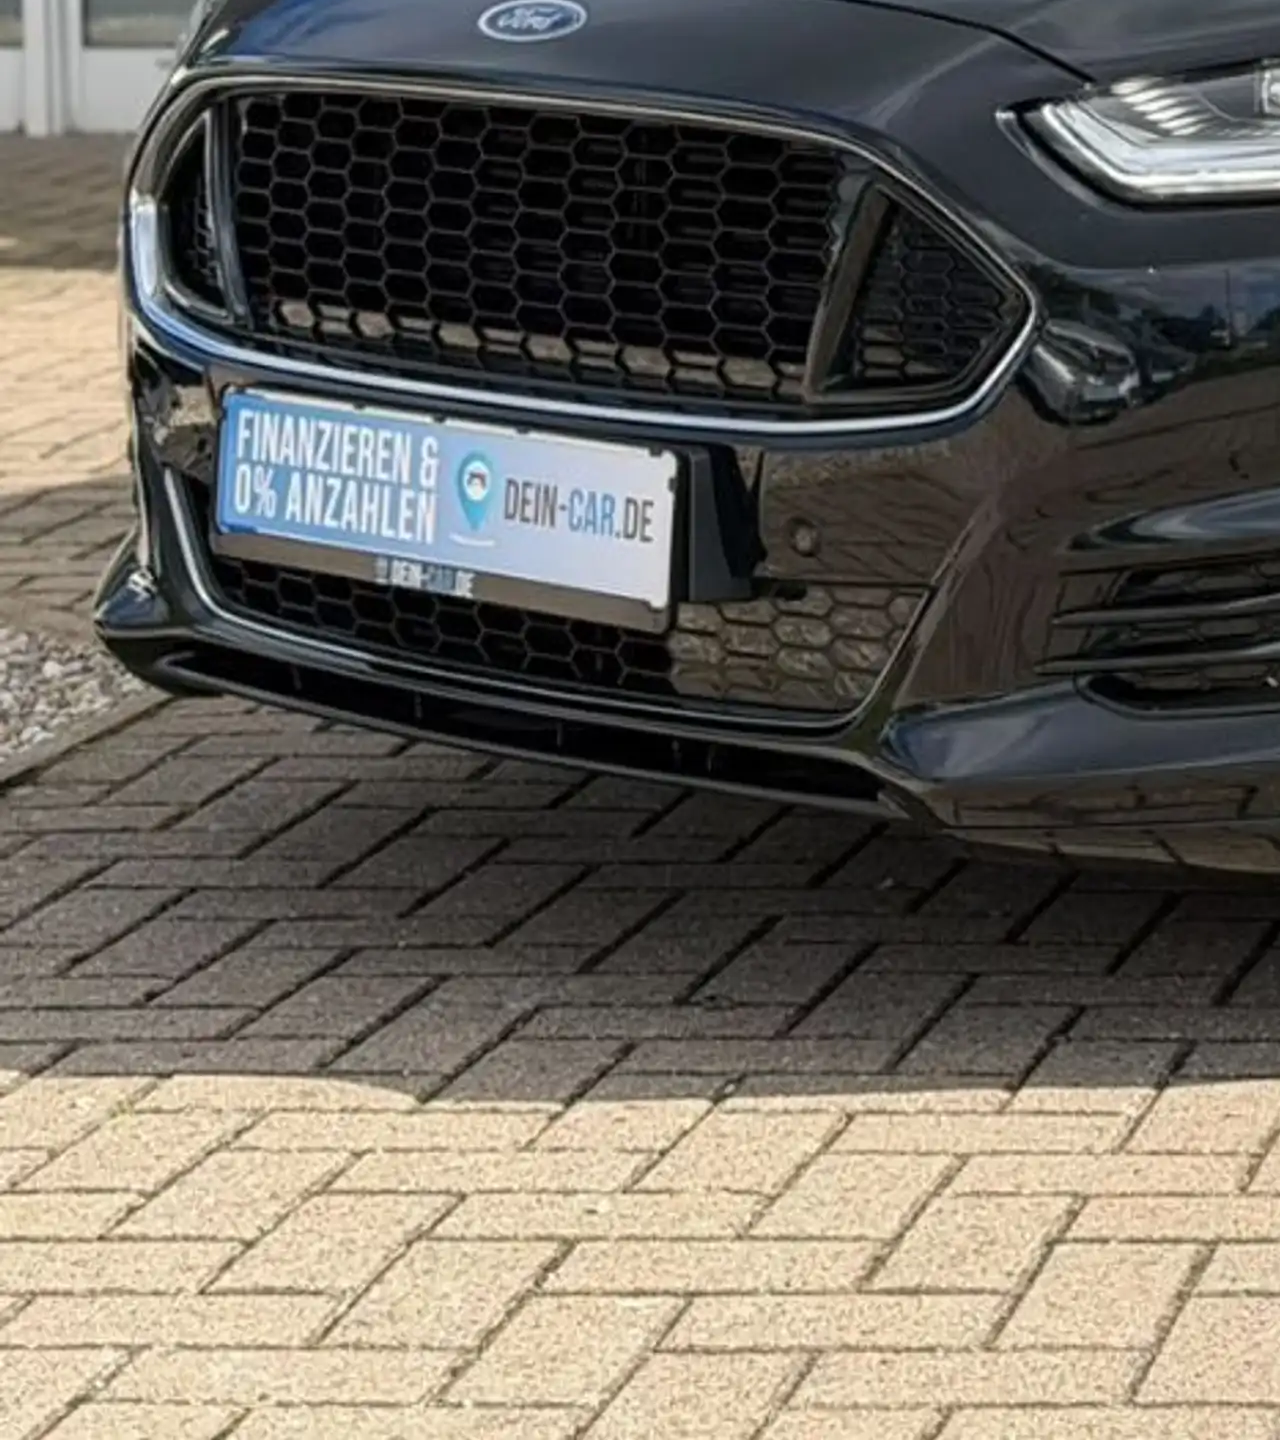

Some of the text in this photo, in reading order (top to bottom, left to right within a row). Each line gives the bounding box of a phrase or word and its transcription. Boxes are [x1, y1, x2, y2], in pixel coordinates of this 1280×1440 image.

[236, 409, 413, 485] FINANZIEREN
[234, 462, 438, 546] 0% ANZAHLEN
[503, 476, 655, 544] DEIN-CAR.DE
